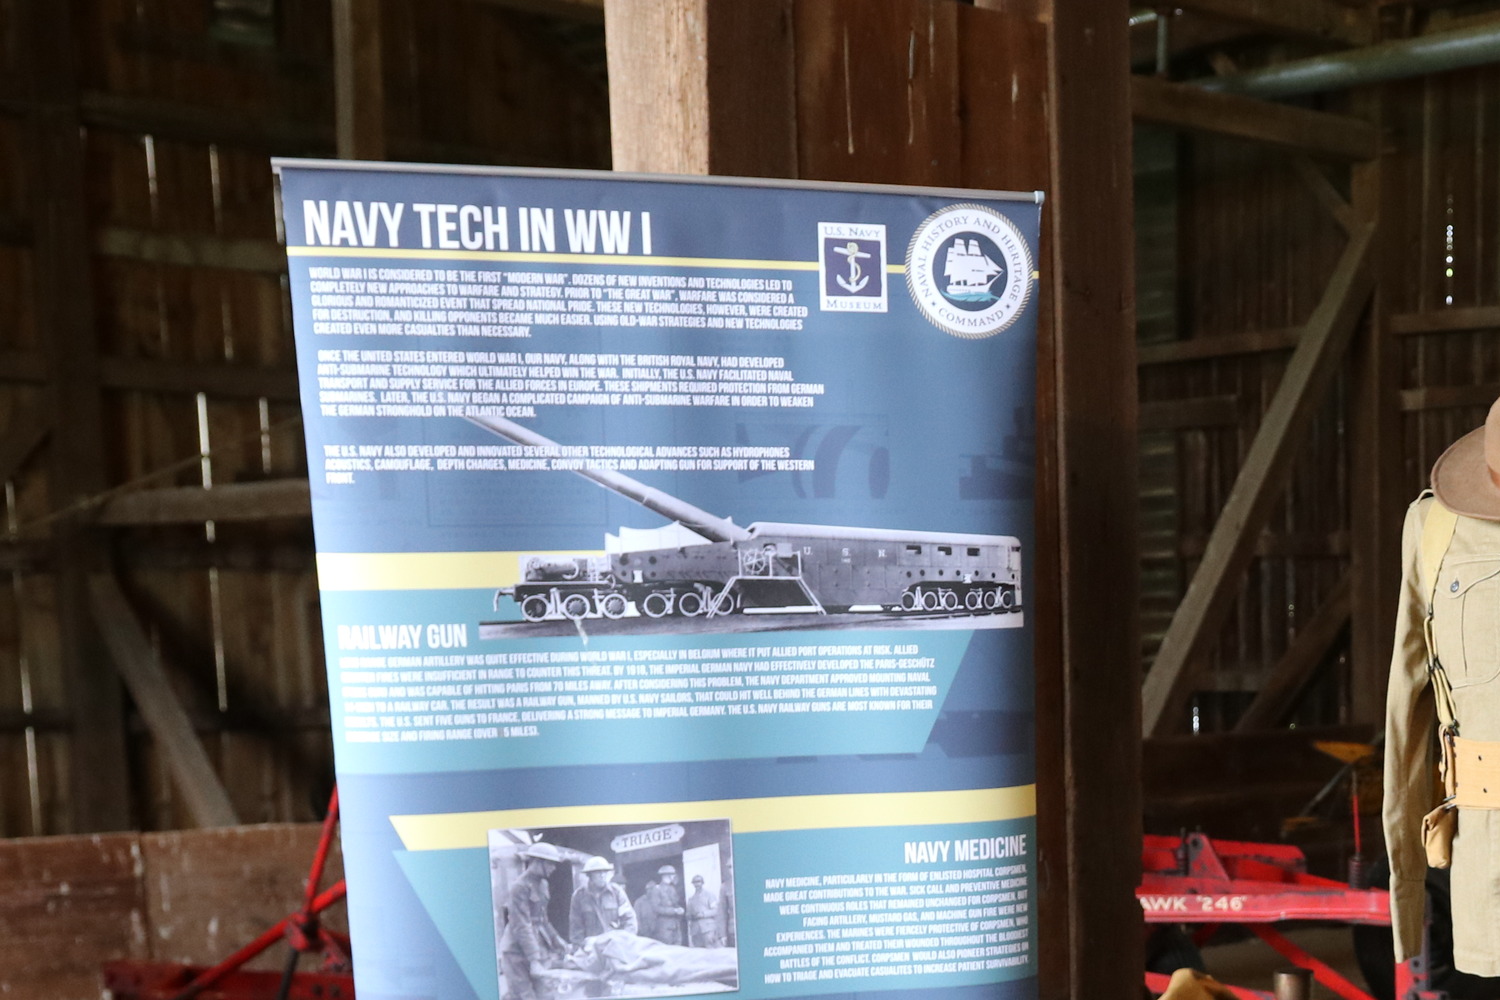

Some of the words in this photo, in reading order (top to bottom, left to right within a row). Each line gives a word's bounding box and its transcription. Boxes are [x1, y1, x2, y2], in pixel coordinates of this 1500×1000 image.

[303, 200, 404, 246] NAVY
[412, 203, 509, 250] TECH
[518, 207, 555, 252] IN
[563, 209, 631, 254] WW
[641, 211, 652, 254] I
[823, 226, 844, 236] U.S.
[922, 215, 970, 250] HISTORY
[973, 216, 1001, 236] AND
[308, 267, 340, 280] WORLD
[341, 268, 362, 280] WAR
[368, 268, 378, 281] IS
[379, 269, 432, 282] CONSIDERED
[434, 270, 446, 282] TO
[447, 270, 459, 282] BE
[460, 271, 476, 283] THE
[478, 271, 502, 283] FIRST
[572, 274, 605, 286] DOZENS
[606, 275, 618, 286] OF
[618, 275, 637, 286] NEW
[638, 276, 686, 288] INVENTIONS
[688, 277, 704, 288] AND
[706, 278, 765, 290] TECHNOLOGIES
[765, 279, 780, 290] LED
[782, 280, 793, 290] TO
[916, 254, 933, 298] NAVAL
[1000, 233, 1022, 302] HERITAGE
[310, 281, 366, 294] COMPLETELY
[367, 283, 388, 294] NEW
[389, 283, 445, 295] APPROACHES
[447, 284, 458, 296] TO
[459, 285, 499, 297] WARFARE
[501, 286, 519, 297] AND
[565, 287, 590, 299] PRIOR
[591, 288, 602, 299] TO
[625, 289, 651, 300] GREAT
[679, 290, 717, 302] WARFARE
[718, 291, 737, 302] WAS
[738, 292, 786, 303] CONSIDERED
[826, 299, 883, 311] MUSEUM
[938, 307, 1004, 328] COMMAND
[314, 322, 352, 335] CREATED
[354, 323, 377, 335] EVEN
[378, 324, 403, 335] MORE
[404, 324, 456, 336] CASUALTIES
[457, 325, 480, 336] THAN
[324, 445, 340, 457] THE
[359, 445, 382, 457] NAVY
[384, 445, 406, 457] ALSO
[407, 445, 456, 457] DEVELOPED
[458, 445, 475, 457] AND
[476, 445, 522, 457] INNOVATED
[524, 445, 560, 457] SEVERAL
[562, 446, 589, 457] OTHER
[590, 446, 654, 457] TECHNOLOGICAL
[656, 446, 697, 458] ADVANCES
[698, 446, 719, 458] SUCH
[721, 447, 731, 458] AS
[732, 447, 790, 458] HYDROPHONES
[337, 624, 422, 650] RAILWAY
[426, 623, 468, 649] GUN
[621, 828, 673, 848] TRIAGE
[904, 840, 950, 864] NAVY
[954, 834, 1027, 862] MEDICINE
[765, 878, 784, 889] NAVY
[823, 874, 873, 886] PARTICULARLY
[884, 873, 898, 883] THE
[899, 872, 919, 882] FORM
[930, 869, 962, 881] ENLISTED
[963, 867, 994, 879] HOSPITAL
[764, 891, 784, 903] MADE
[785, 890, 807, 901] GREAT
[808, 887, 863, 900] CONTRIBUTIONS
[865, 887, 874, 897] TO
[875, 886, 889, 896] THE
[890, 885, 908, 896] WAR.
[910, 884, 926, 895] SICK
[927, 883, 944, 894] CALL
[945, 883, 960, 893] AND
[961, 880, 1000, 892] PREVENTIVE
